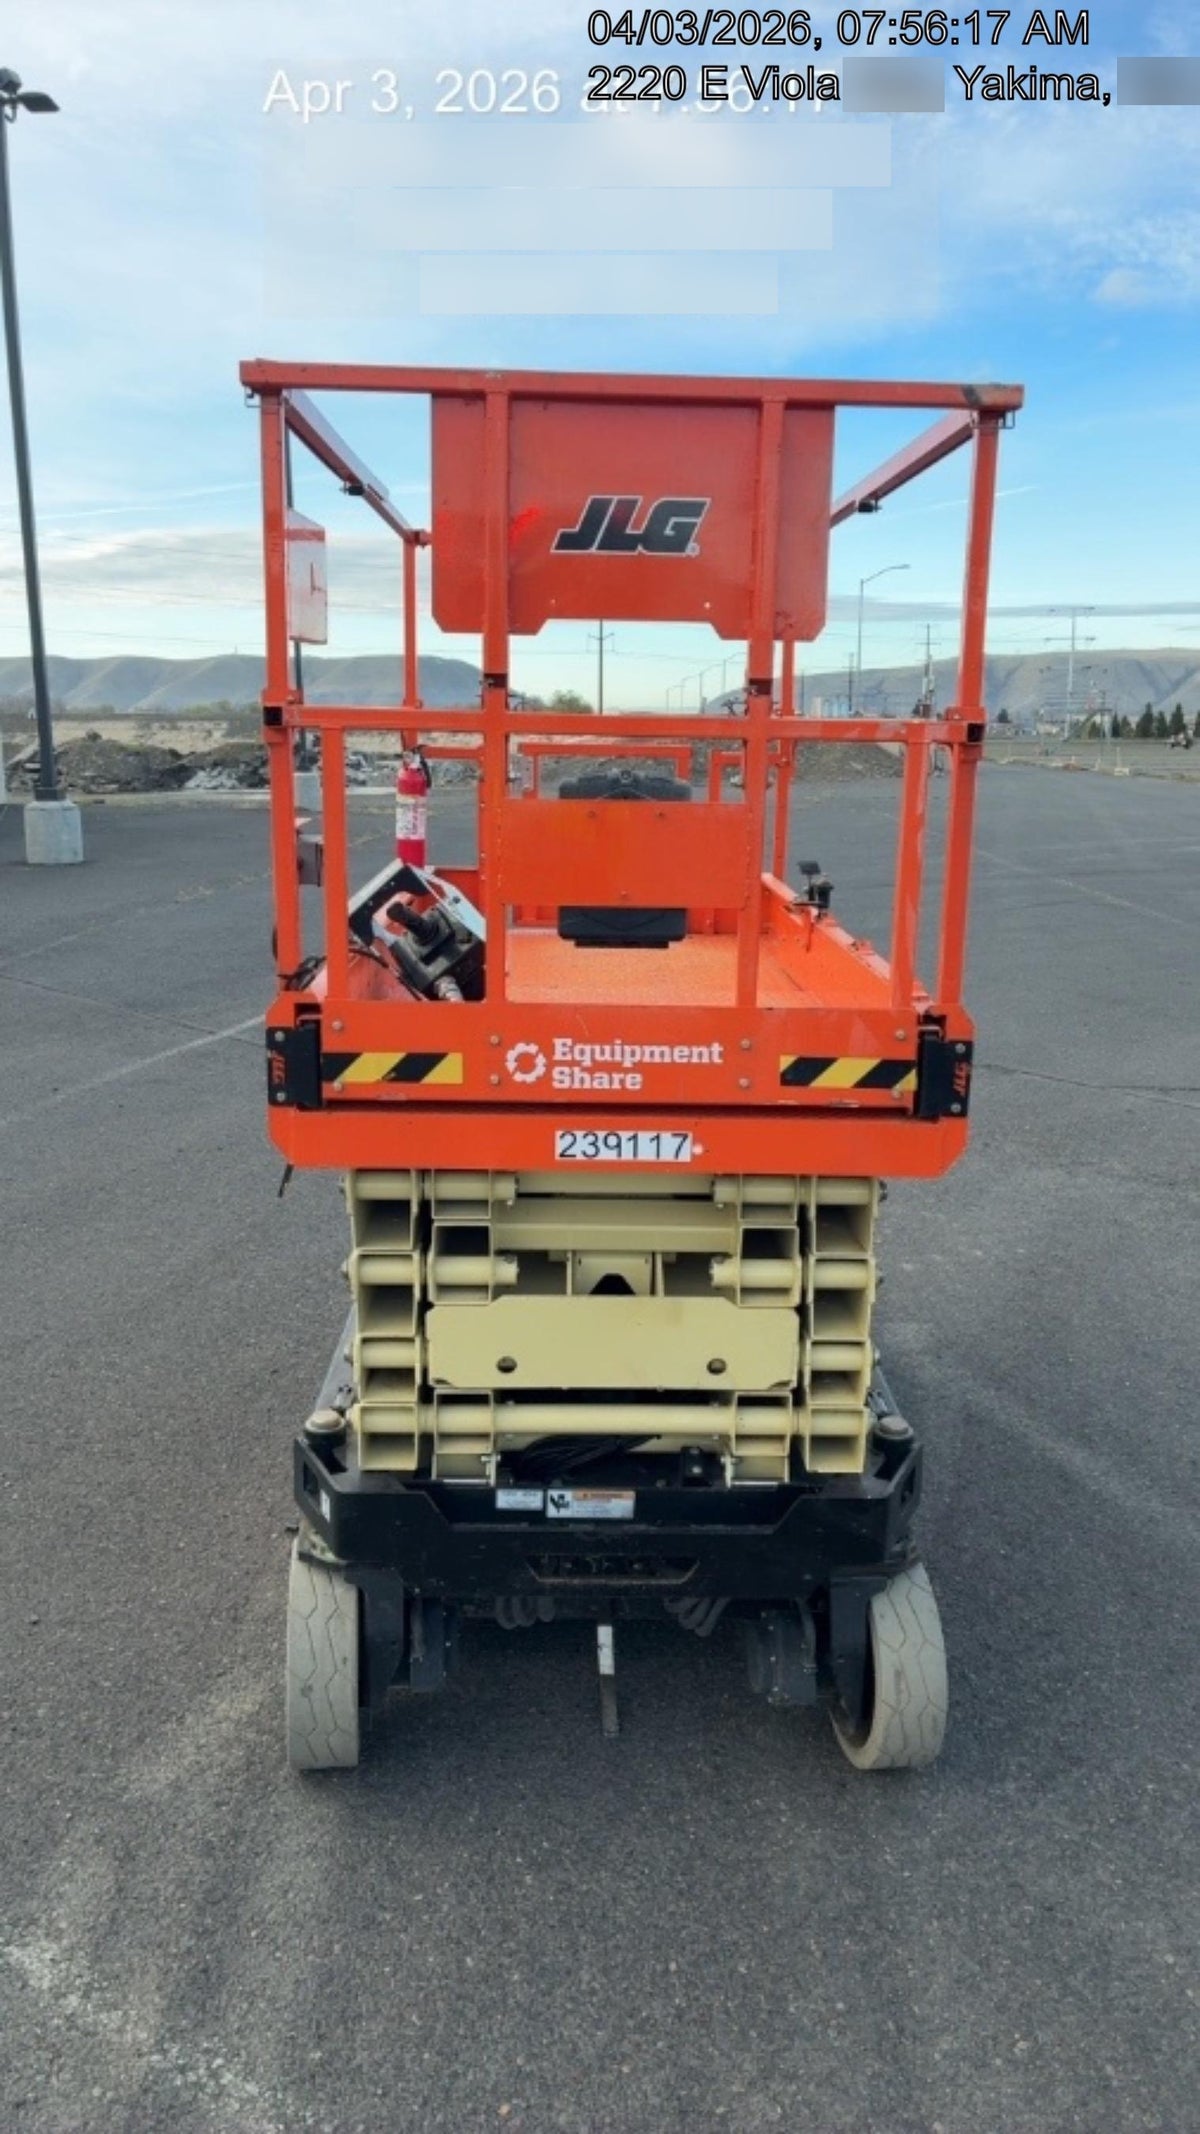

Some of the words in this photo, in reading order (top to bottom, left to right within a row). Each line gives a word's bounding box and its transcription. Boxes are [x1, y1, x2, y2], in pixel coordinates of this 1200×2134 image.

[551, 495, 711, 557] JLG
[552, 1038, 724, 1067] Equipment
[552, 1066, 643, 1090] Share
[557, 1131, 690, 1161] 239117
